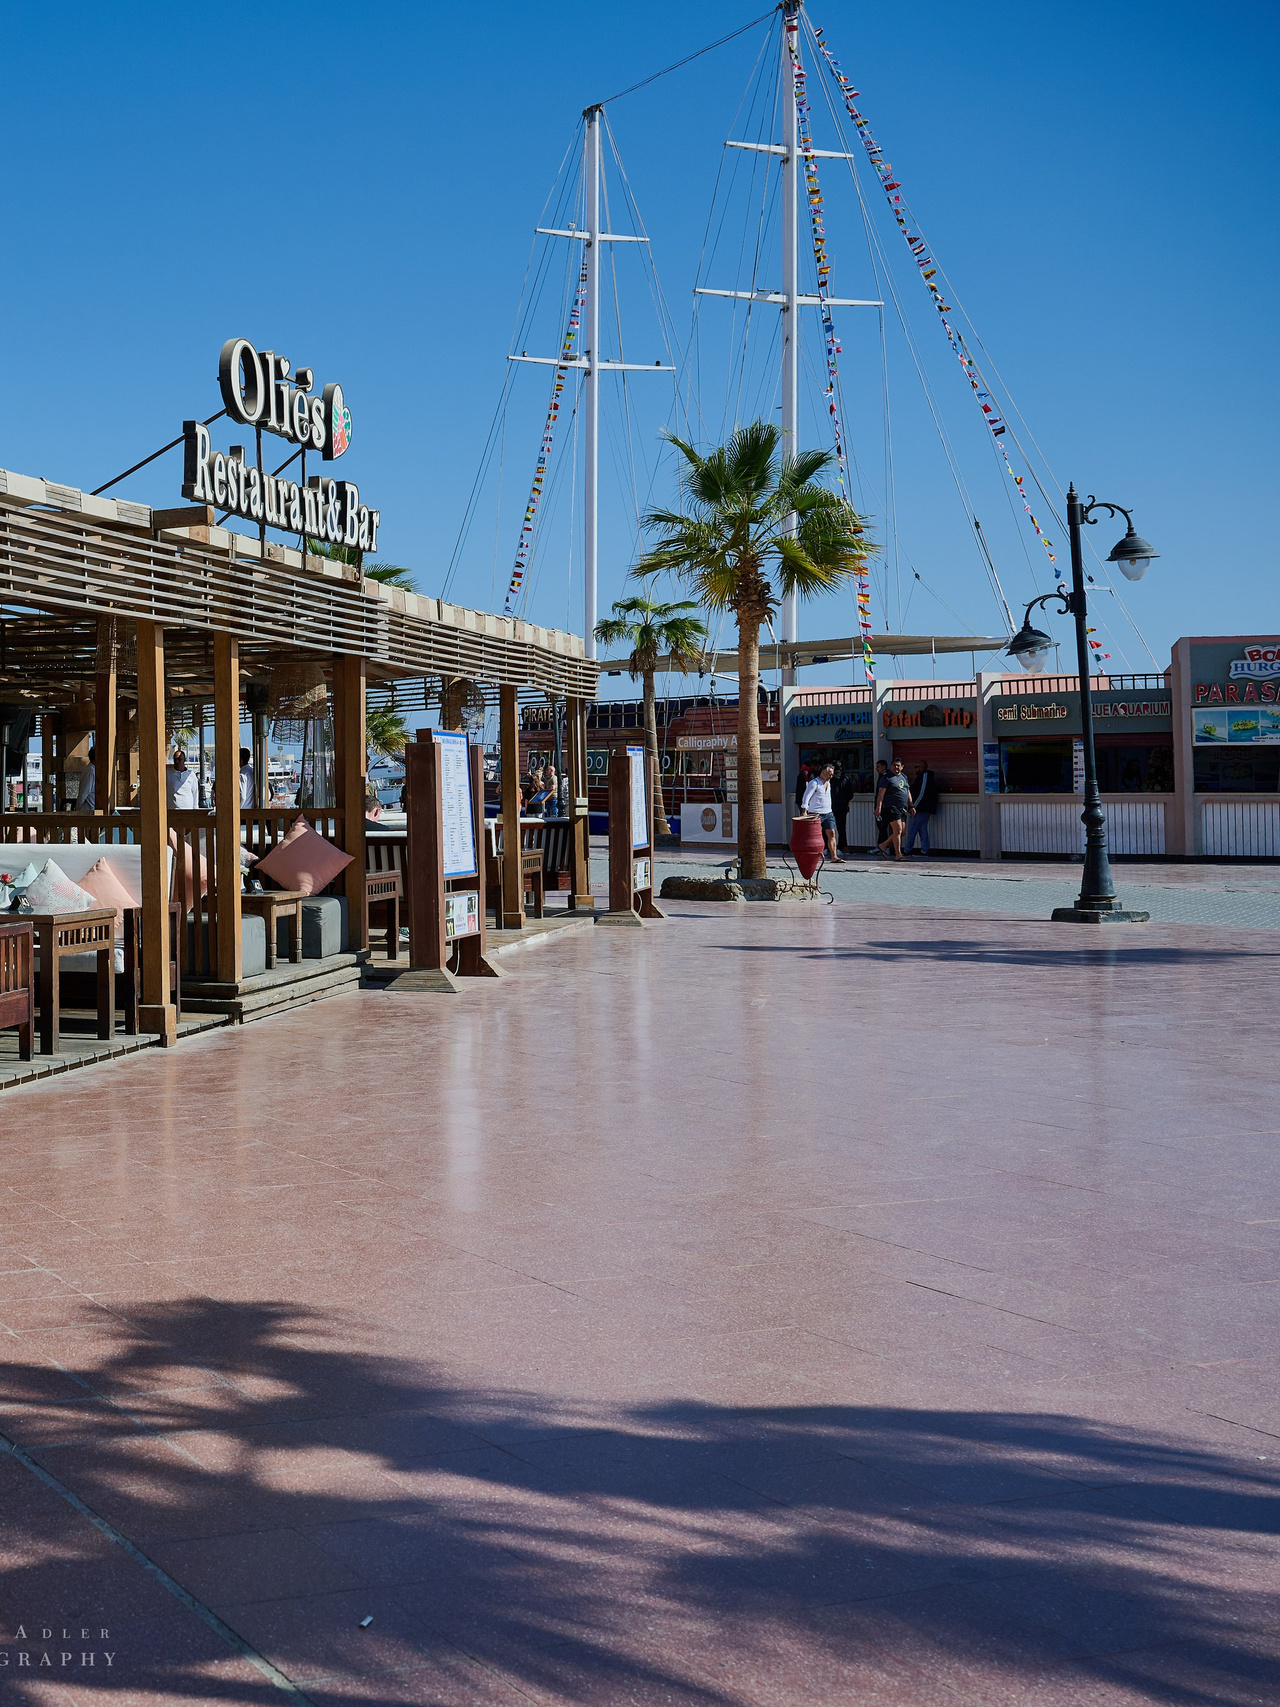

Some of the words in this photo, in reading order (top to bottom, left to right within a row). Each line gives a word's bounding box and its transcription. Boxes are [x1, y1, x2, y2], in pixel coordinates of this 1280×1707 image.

[222, 338, 326, 450] Olie's
[186, 421, 326, 538] Restaurant
[344, 483, 380, 553] Bar
[1195, 682, 1280, 703] PARAS
[882, 709, 921, 727] Safari
[1021, 703, 1067, 720] Submarine
[1090, 703, 1110, 717] LUE
[1111, 701, 1170, 718] AQUARIUM
[678, 735, 728, 750] Calligraphy
